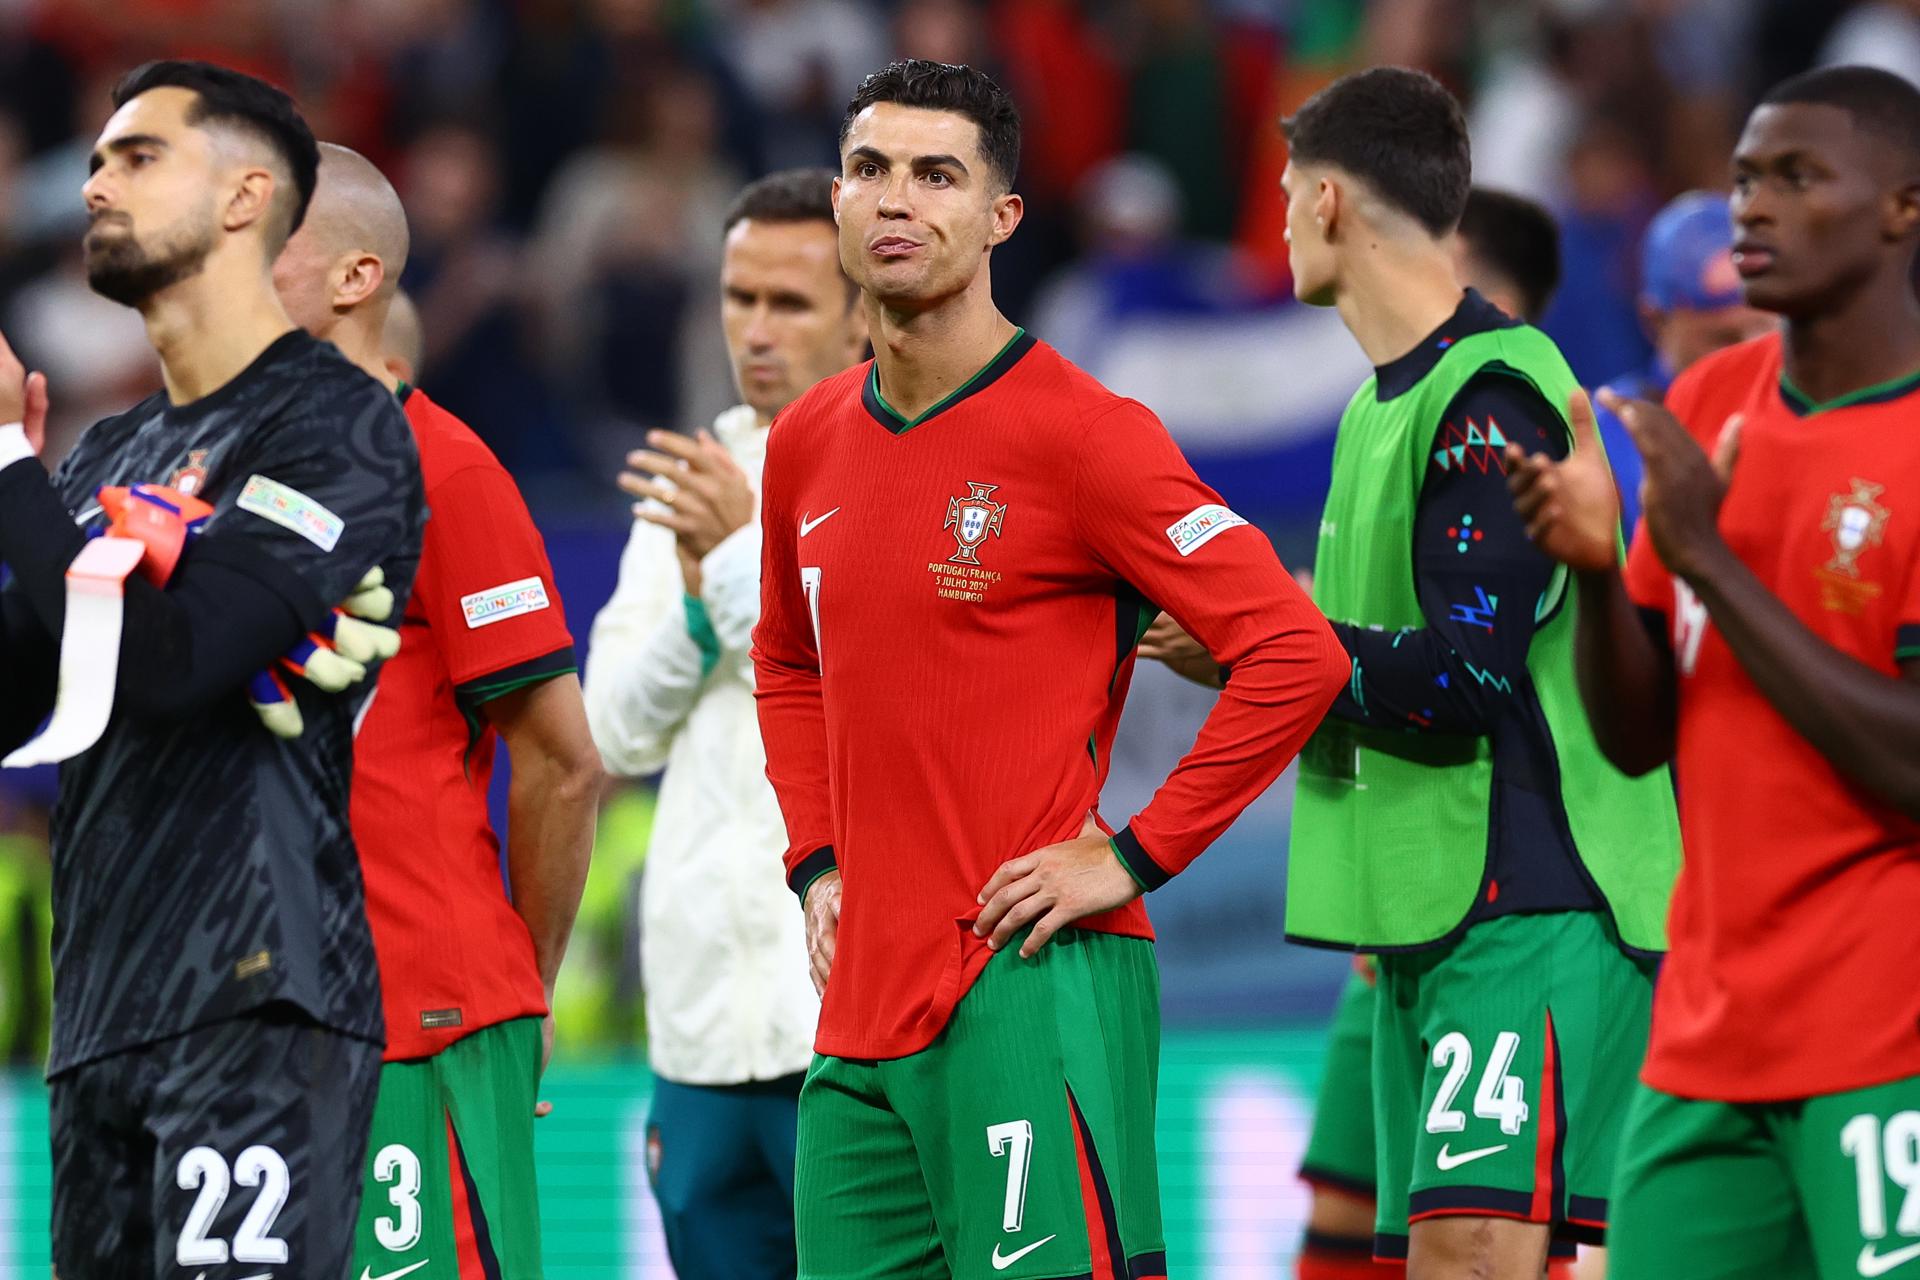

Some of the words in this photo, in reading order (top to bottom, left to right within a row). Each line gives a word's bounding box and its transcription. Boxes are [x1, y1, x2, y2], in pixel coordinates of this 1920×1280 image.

[1169, 521, 1188, 538] UEFA
[1174, 511, 1239, 547] FOUNDAT
[927, 562, 1001, 583] PORTUGAL/FRANÇA
[935, 576, 941, 585] 5
[942, 577, 967, 589] JULHO
[969, 581, 988, 591] 2024
[938, 587, 983, 603] HAMBURGO
[1426, 1031, 1529, 1136] 24
[176, 1145, 290, 1267] 22
[374, 1144, 422, 1252] 3
[987, 1119, 1033, 1233] 7
[1840, 1109, 1920, 1240] 19
